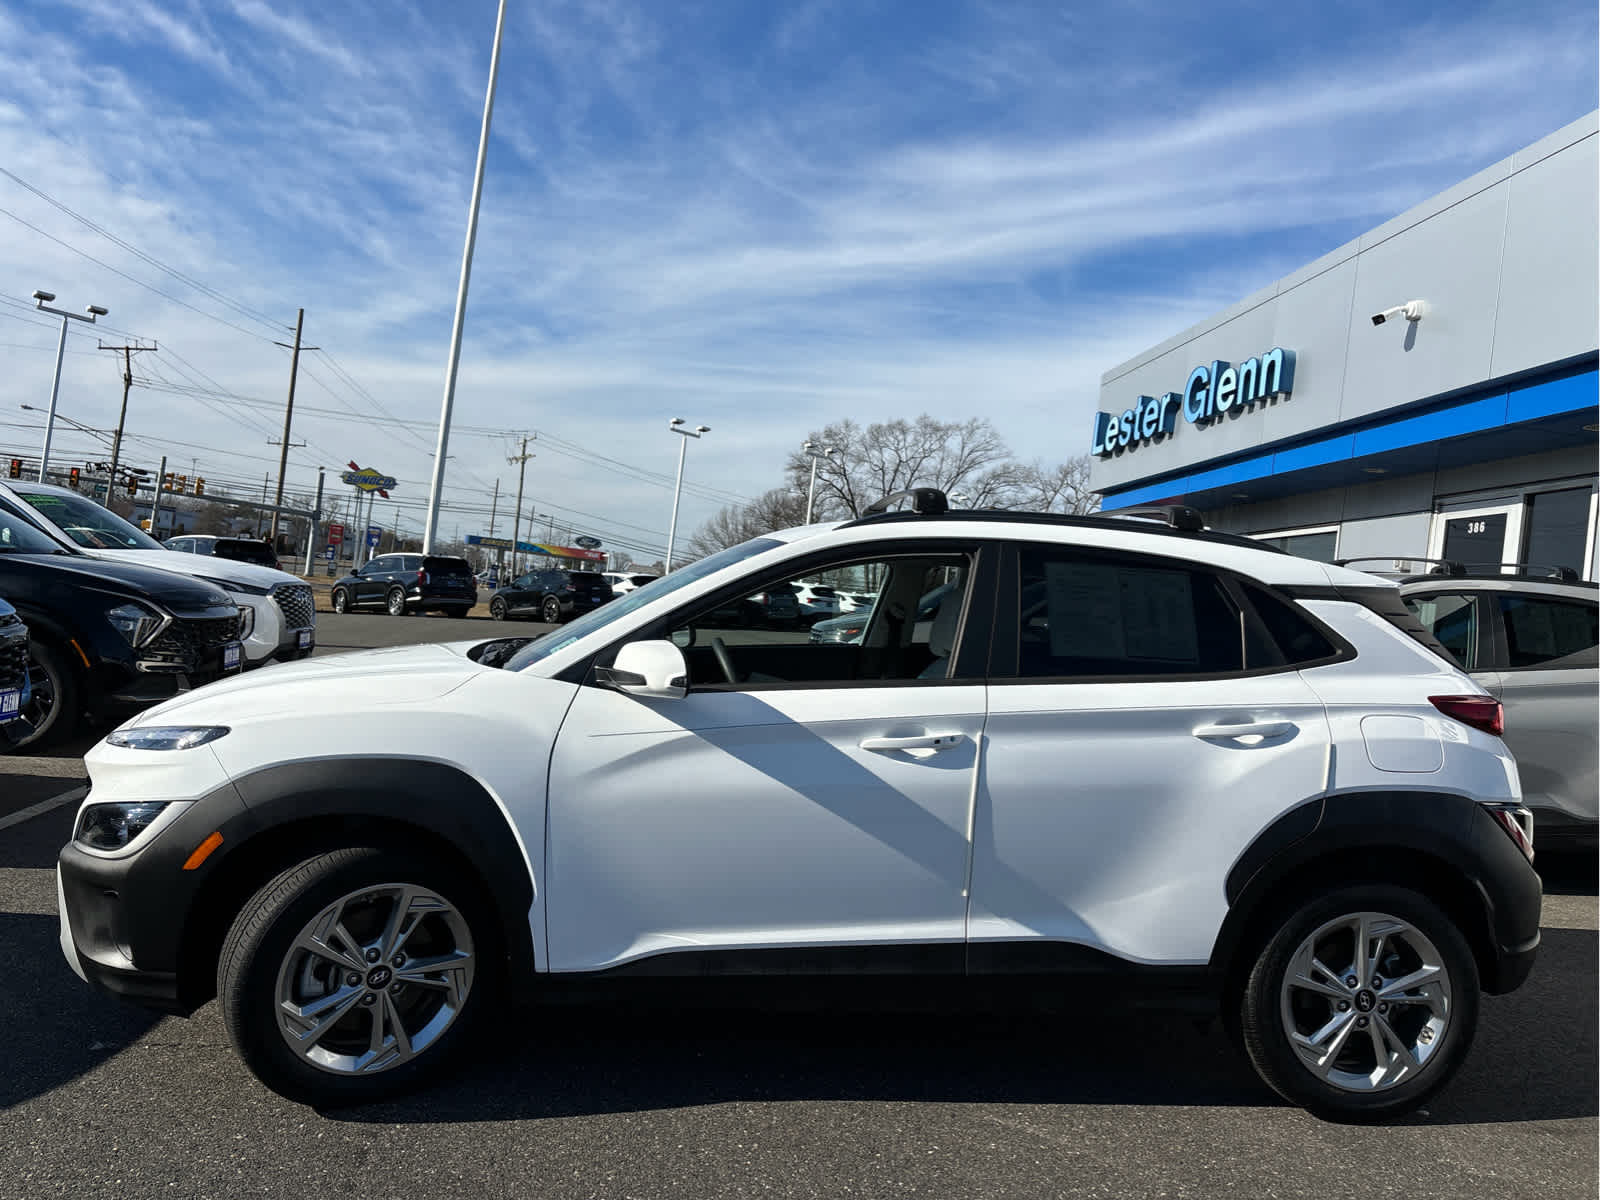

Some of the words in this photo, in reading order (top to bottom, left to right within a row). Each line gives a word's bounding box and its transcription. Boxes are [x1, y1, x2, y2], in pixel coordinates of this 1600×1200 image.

[1091, 391, 1179, 457] Lester
[1184, 347, 1291, 424] Glenn
[346, 472, 396, 489] SUNOCO
[1467, 521, 1486, 534] 386
